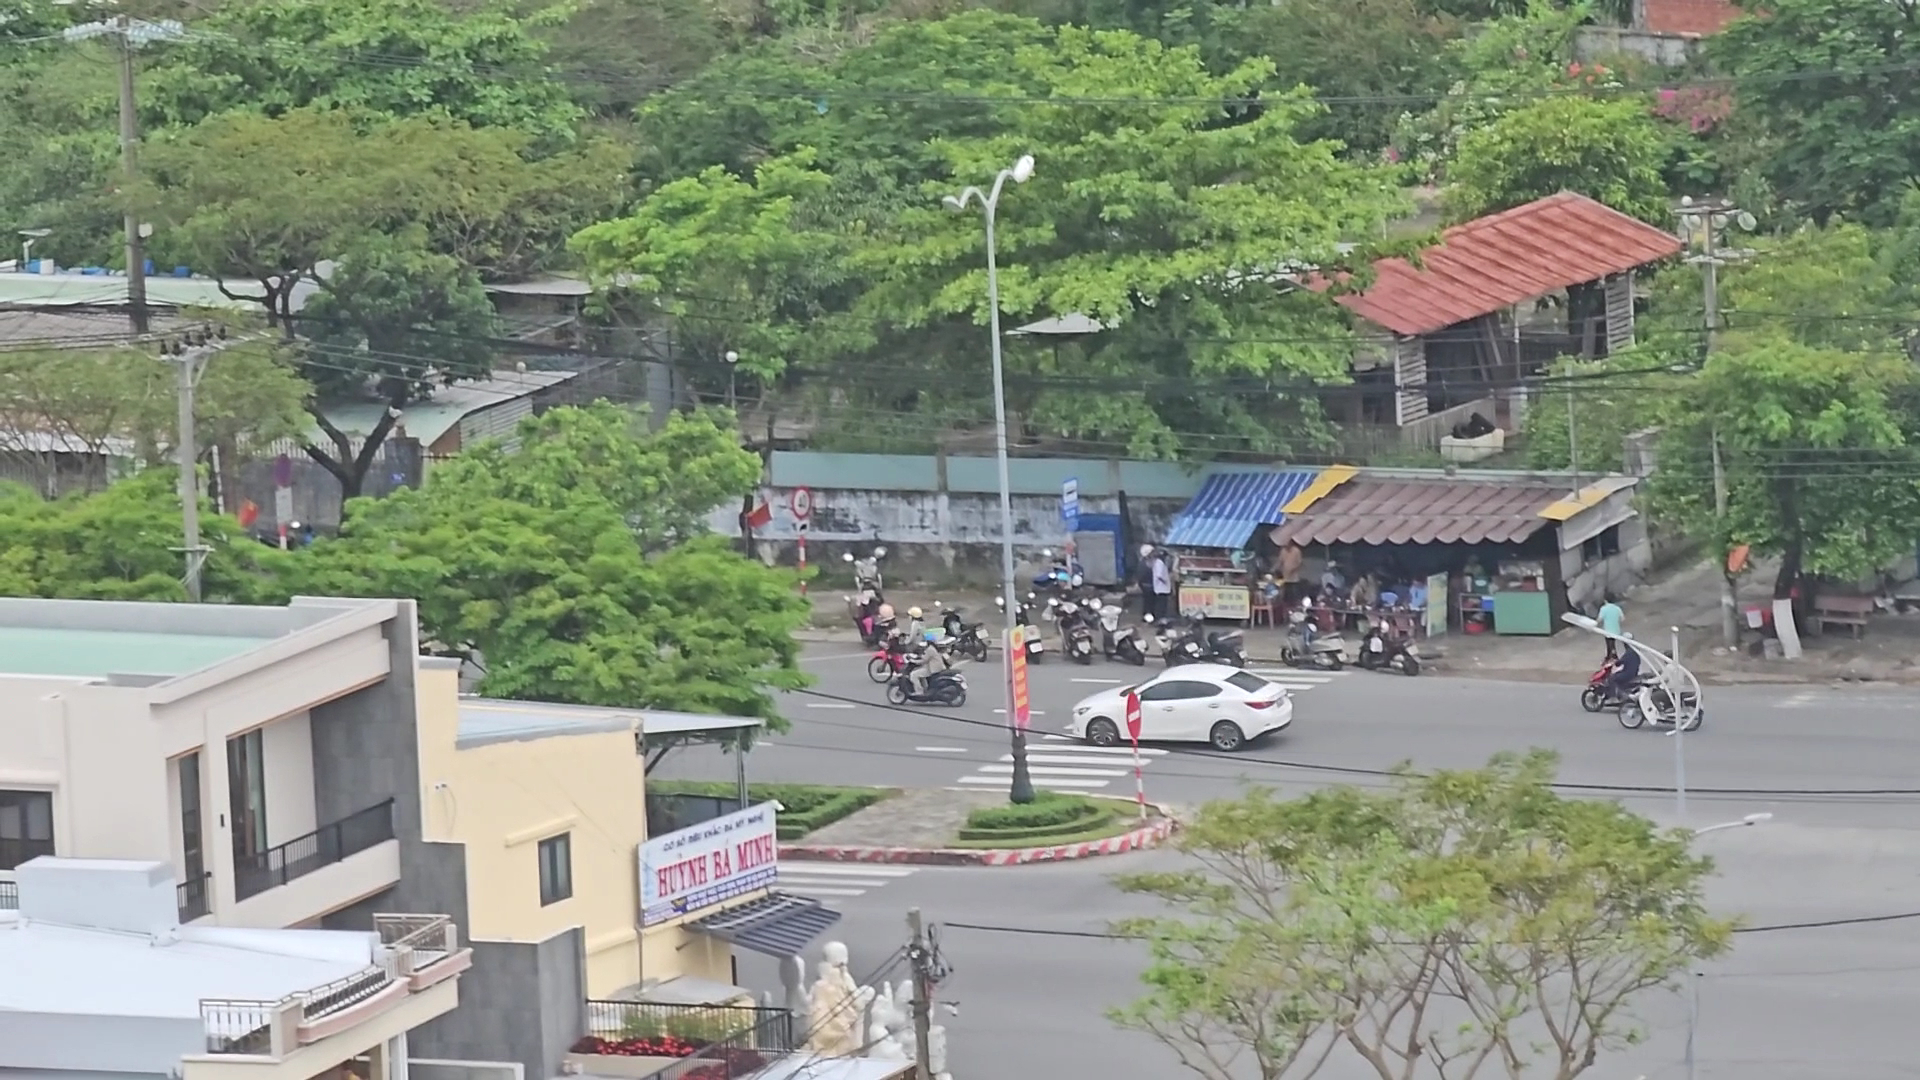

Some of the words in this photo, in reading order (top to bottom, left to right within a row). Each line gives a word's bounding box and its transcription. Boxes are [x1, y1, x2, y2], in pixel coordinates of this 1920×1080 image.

[658, 853, 707, 897] HUỲNH
[713, 838, 732, 880] BÁ
[737, 833, 774, 872] MINH
